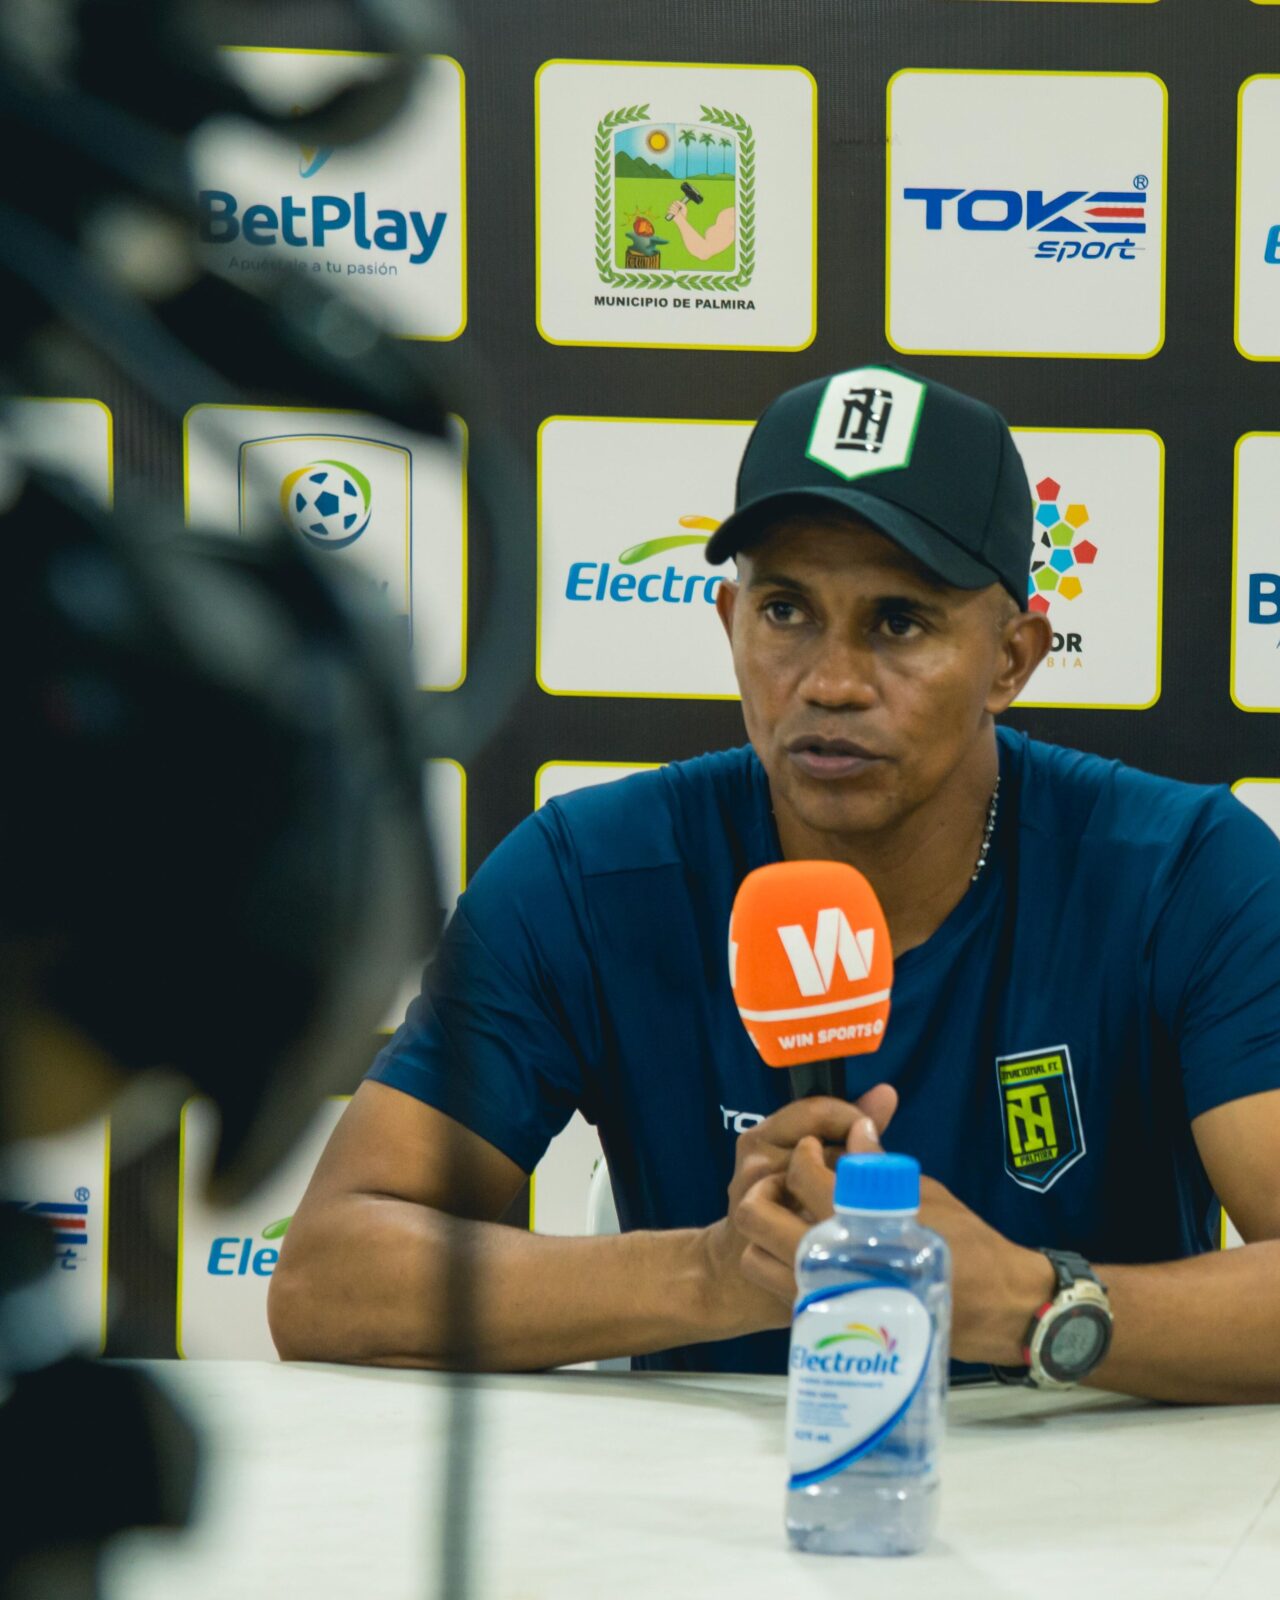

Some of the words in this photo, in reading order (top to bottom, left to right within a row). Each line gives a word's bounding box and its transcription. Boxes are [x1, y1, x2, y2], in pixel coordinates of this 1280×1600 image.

[903, 188, 1147, 234] TOKE
[199, 190, 448, 265] BetPlay
[1034, 238, 1136, 263] sport
[312, 261, 321, 273] a
[326, 261, 342, 273] tu
[346, 261, 398, 276] pasión
[594, 295, 668, 308] MUNICIPIO
[673, 298, 691, 308] DE
[695, 299, 755, 310] PALMIRA
[565, 562, 726, 605] Electro
[778, 1032, 814, 1050] WIN
[720, 1104, 767, 1133] TO
[790, 1345, 899, 1375] Electrolit
